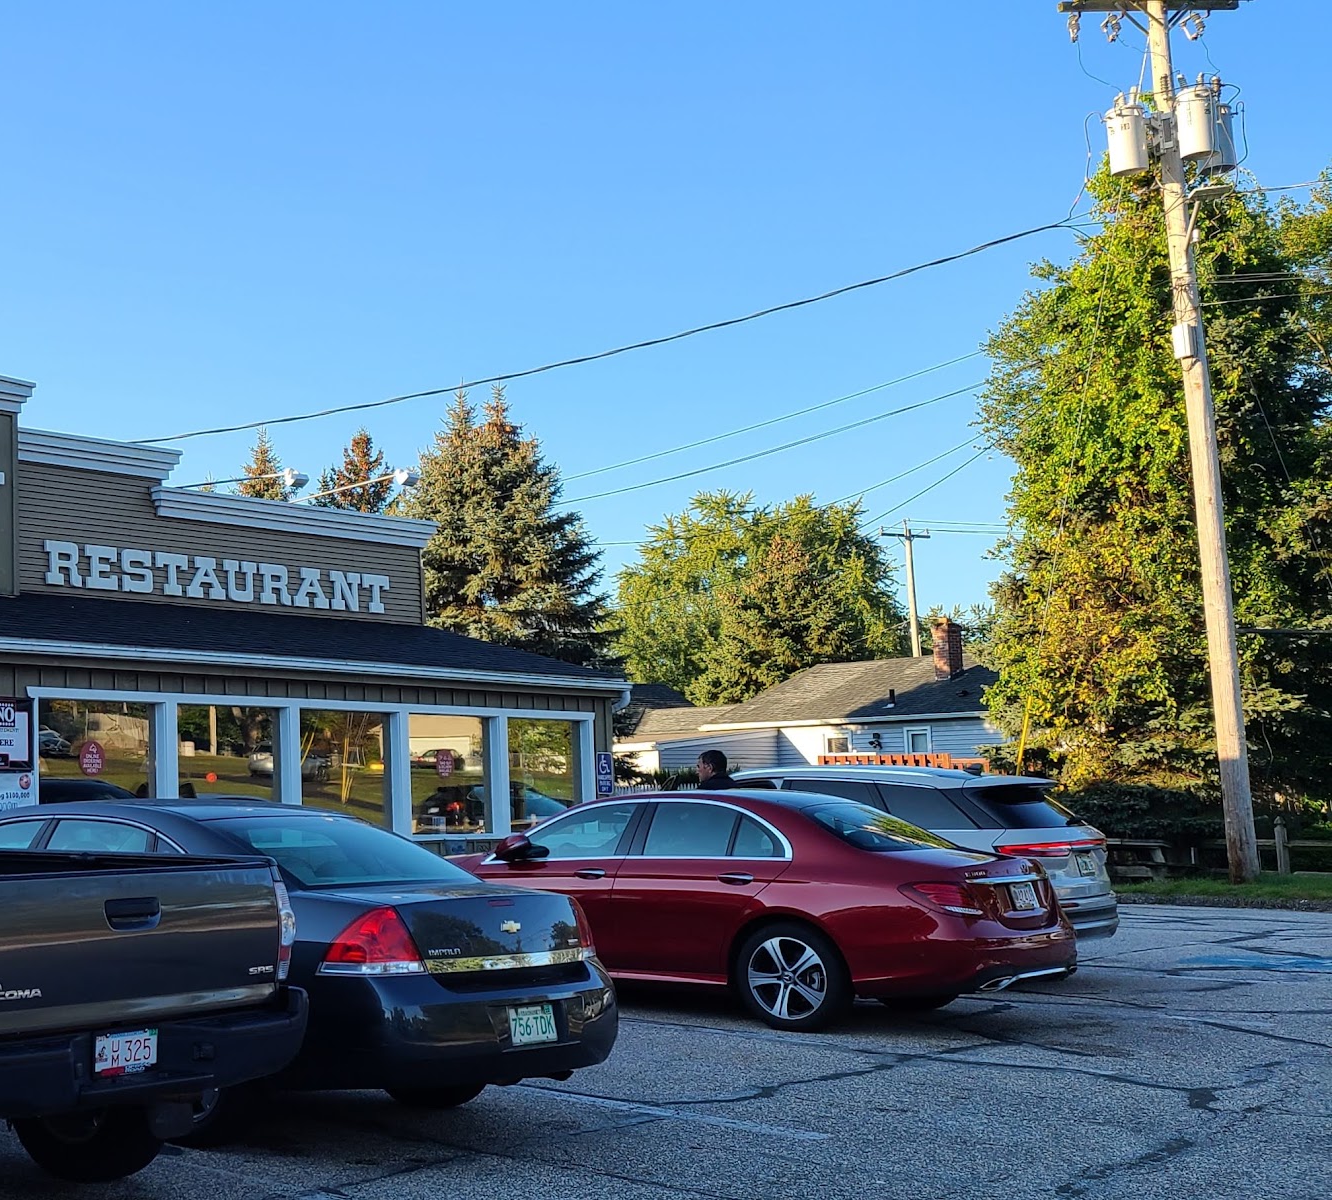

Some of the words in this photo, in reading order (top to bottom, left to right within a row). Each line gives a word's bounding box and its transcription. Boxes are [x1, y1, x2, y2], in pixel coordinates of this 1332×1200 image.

[44, 540, 390, 614] RESTAURANT
[428, 947, 461, 956] IMPALA
[248, 965, 274, 975] SR5
